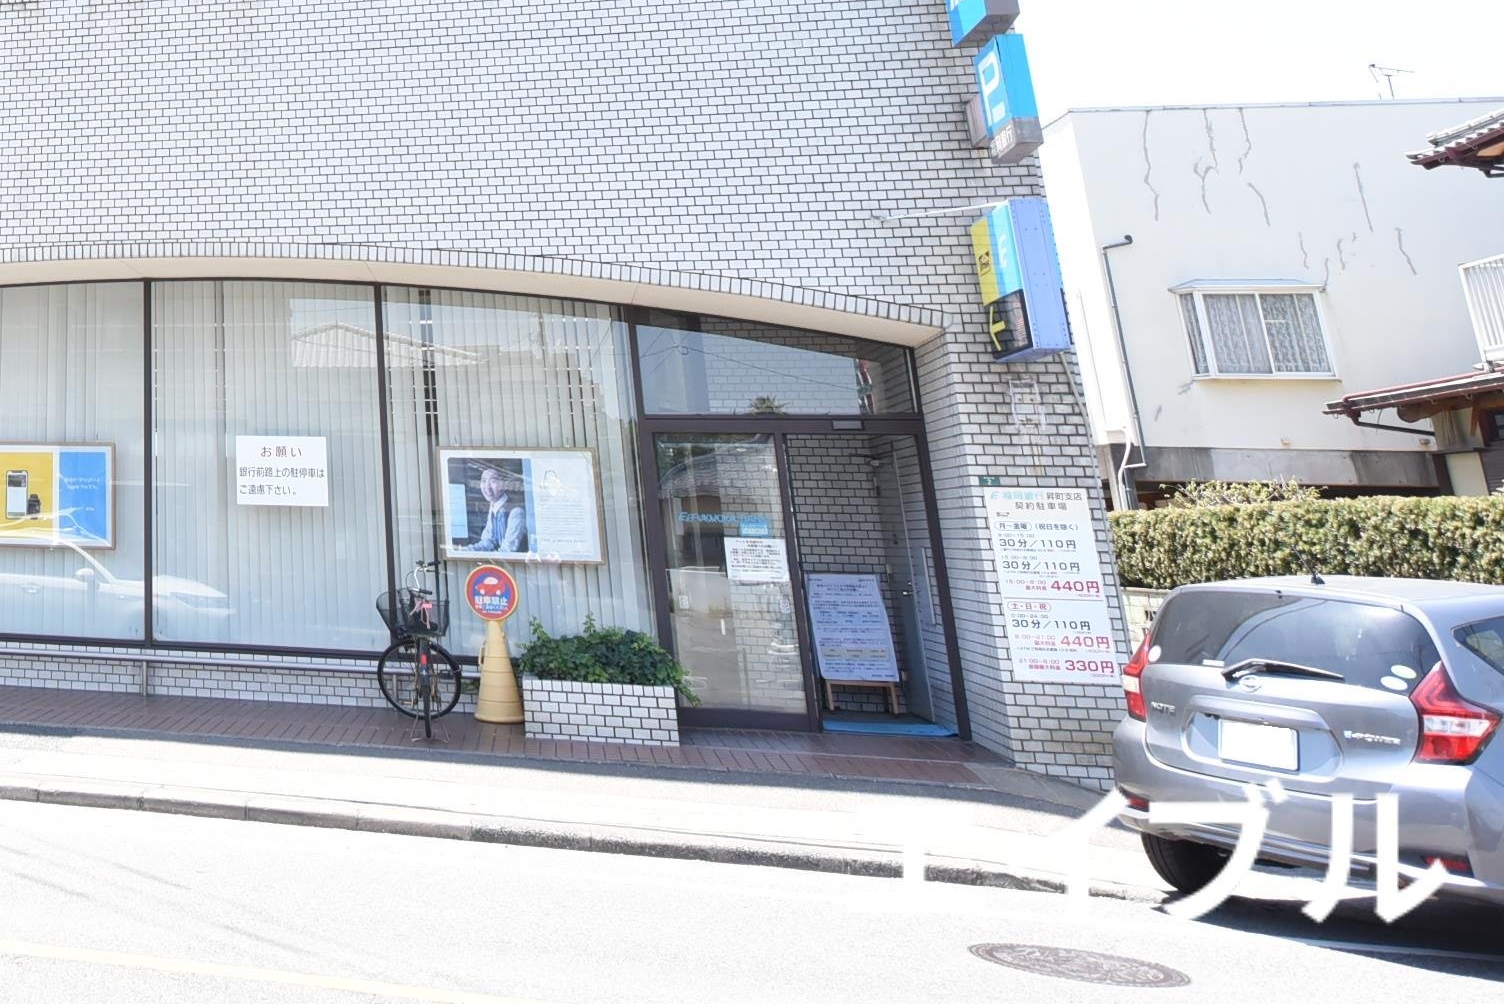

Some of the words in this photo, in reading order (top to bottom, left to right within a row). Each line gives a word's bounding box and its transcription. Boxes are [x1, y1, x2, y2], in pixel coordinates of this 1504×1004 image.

[261, 446, 302, 457] お願い
[239, 467, 325, 478] 銀行前路上の駐停車は
[1015, 502, 1067, 510] 契約駐車場
[1050, 580, 1100, 593] 440円
[1060, 636, 1110, 649] 440円
[1064, 659, 1114, 674] 330円
